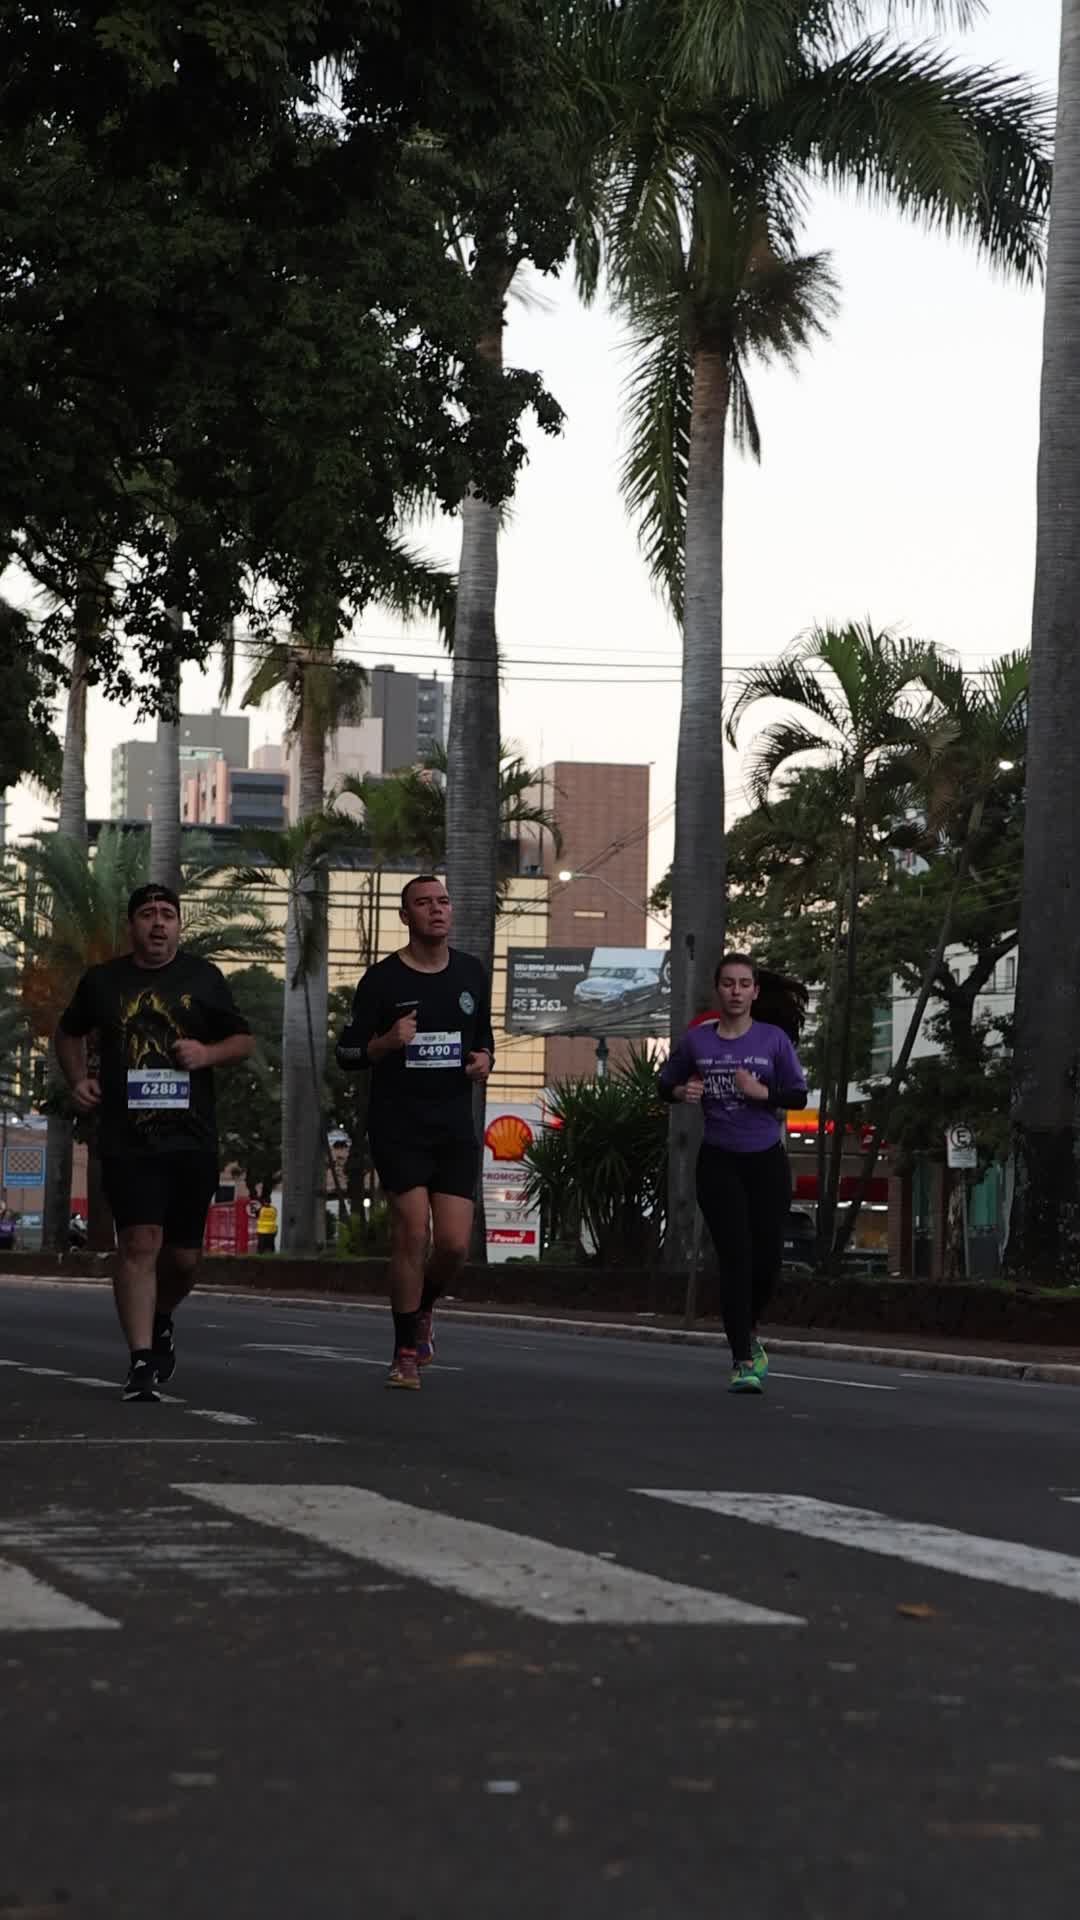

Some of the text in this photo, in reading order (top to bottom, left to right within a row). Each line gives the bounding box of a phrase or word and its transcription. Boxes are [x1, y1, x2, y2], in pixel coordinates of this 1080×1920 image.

[512, 998, 528, 1011] R$
[418, 1045, 451, 1056] 6490
[141, 1082, 178, 1095] 6288
[957, 1130, 967, 1144] E
